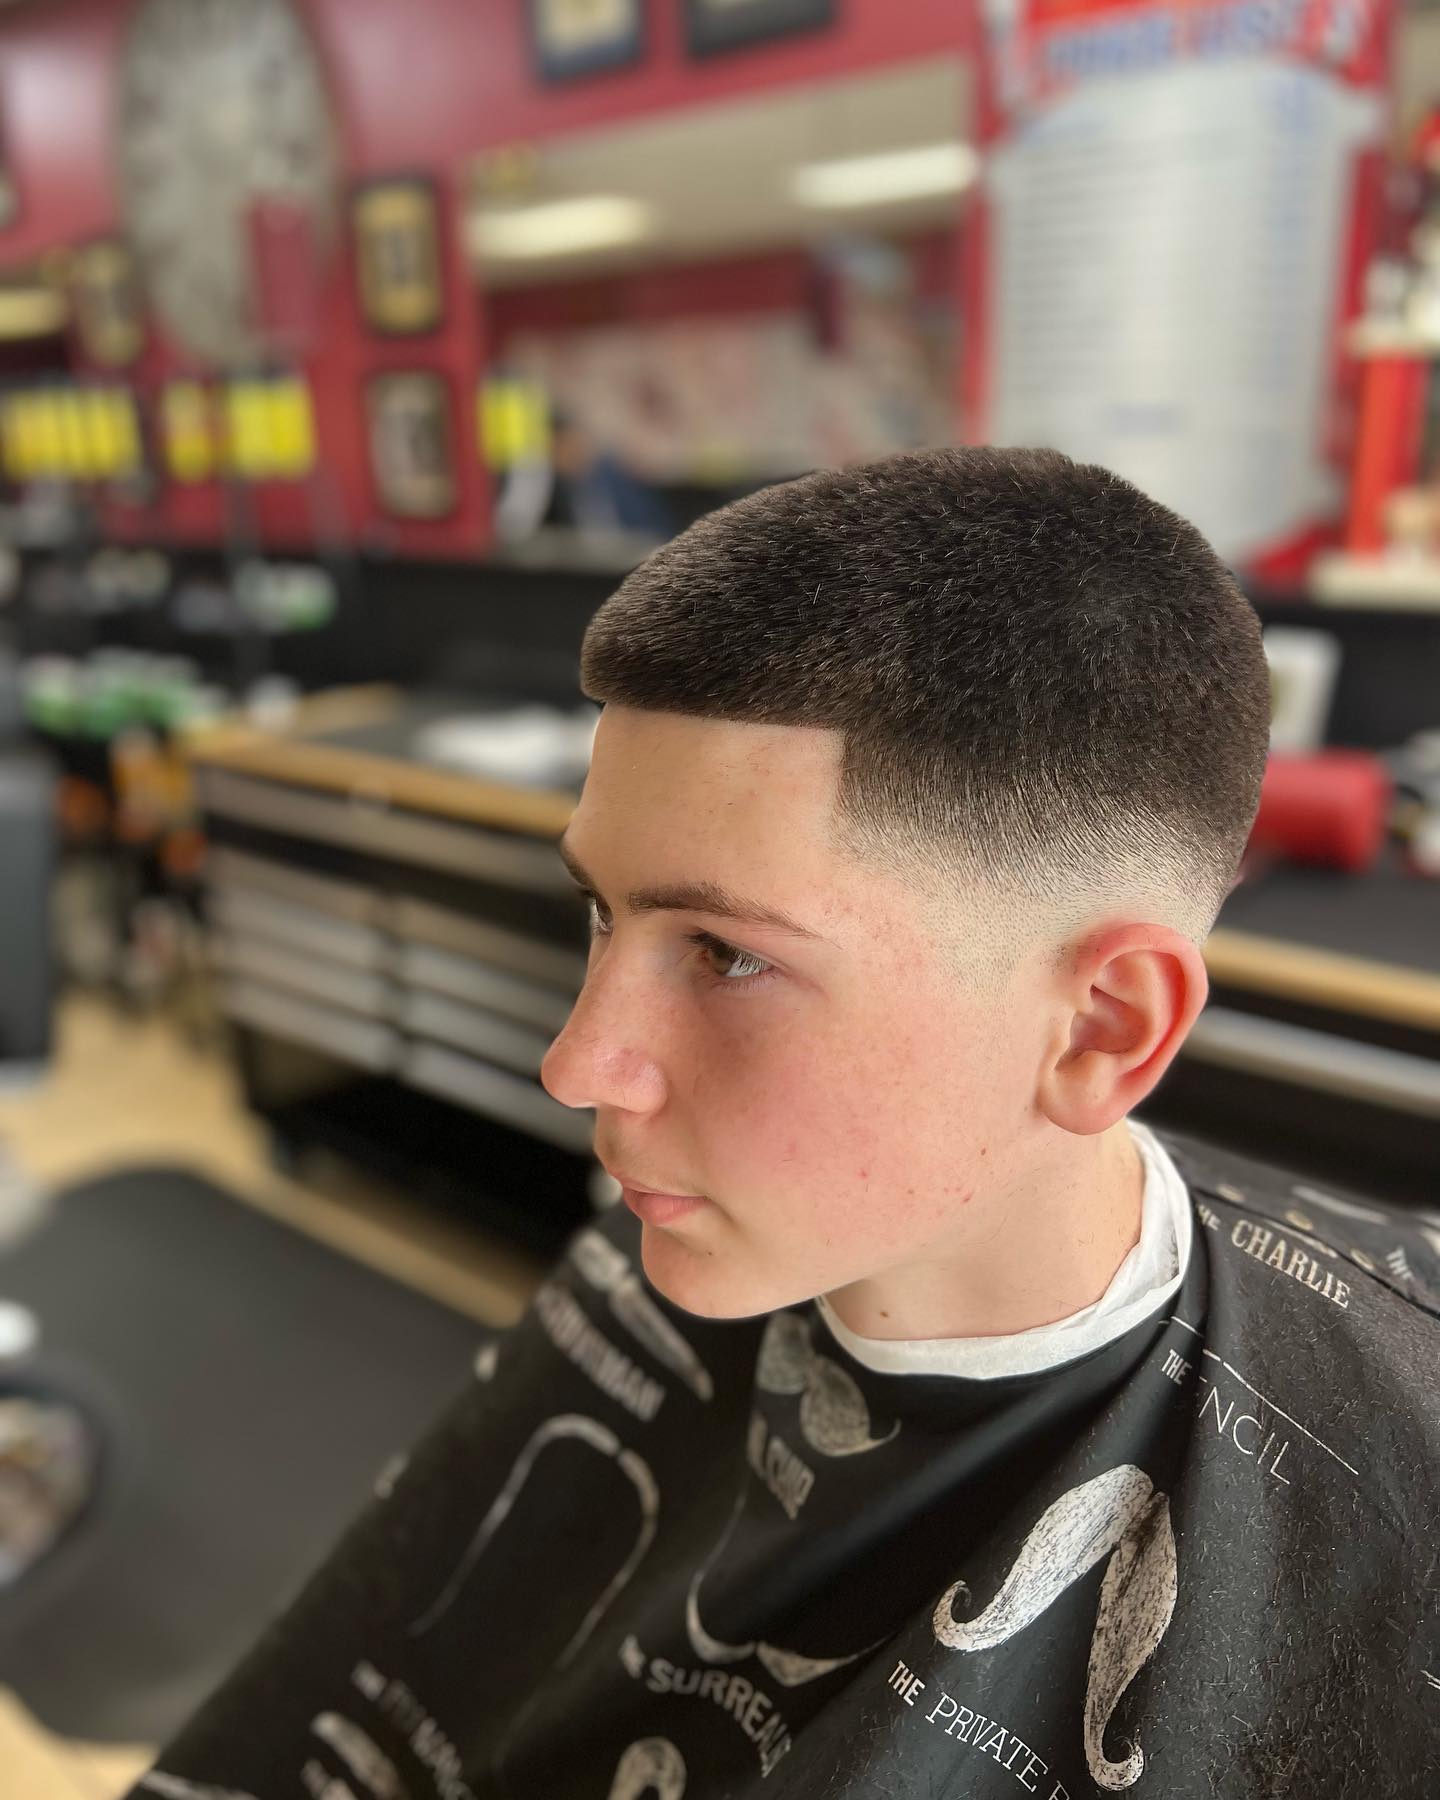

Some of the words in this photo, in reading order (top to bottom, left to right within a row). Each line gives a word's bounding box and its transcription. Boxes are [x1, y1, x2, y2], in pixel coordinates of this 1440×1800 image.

[1196, 1203, 1221, 1231] HE
[1231, 1219, 1350, 1309] CHARLIE
[1161, 1349, 1192, 1385] THE
[1198, 1376, 1290, 1485] NCIL
[888, 1660, 925, 1706] THE
[925, 1692, 1048, 1792] PRIVATE
